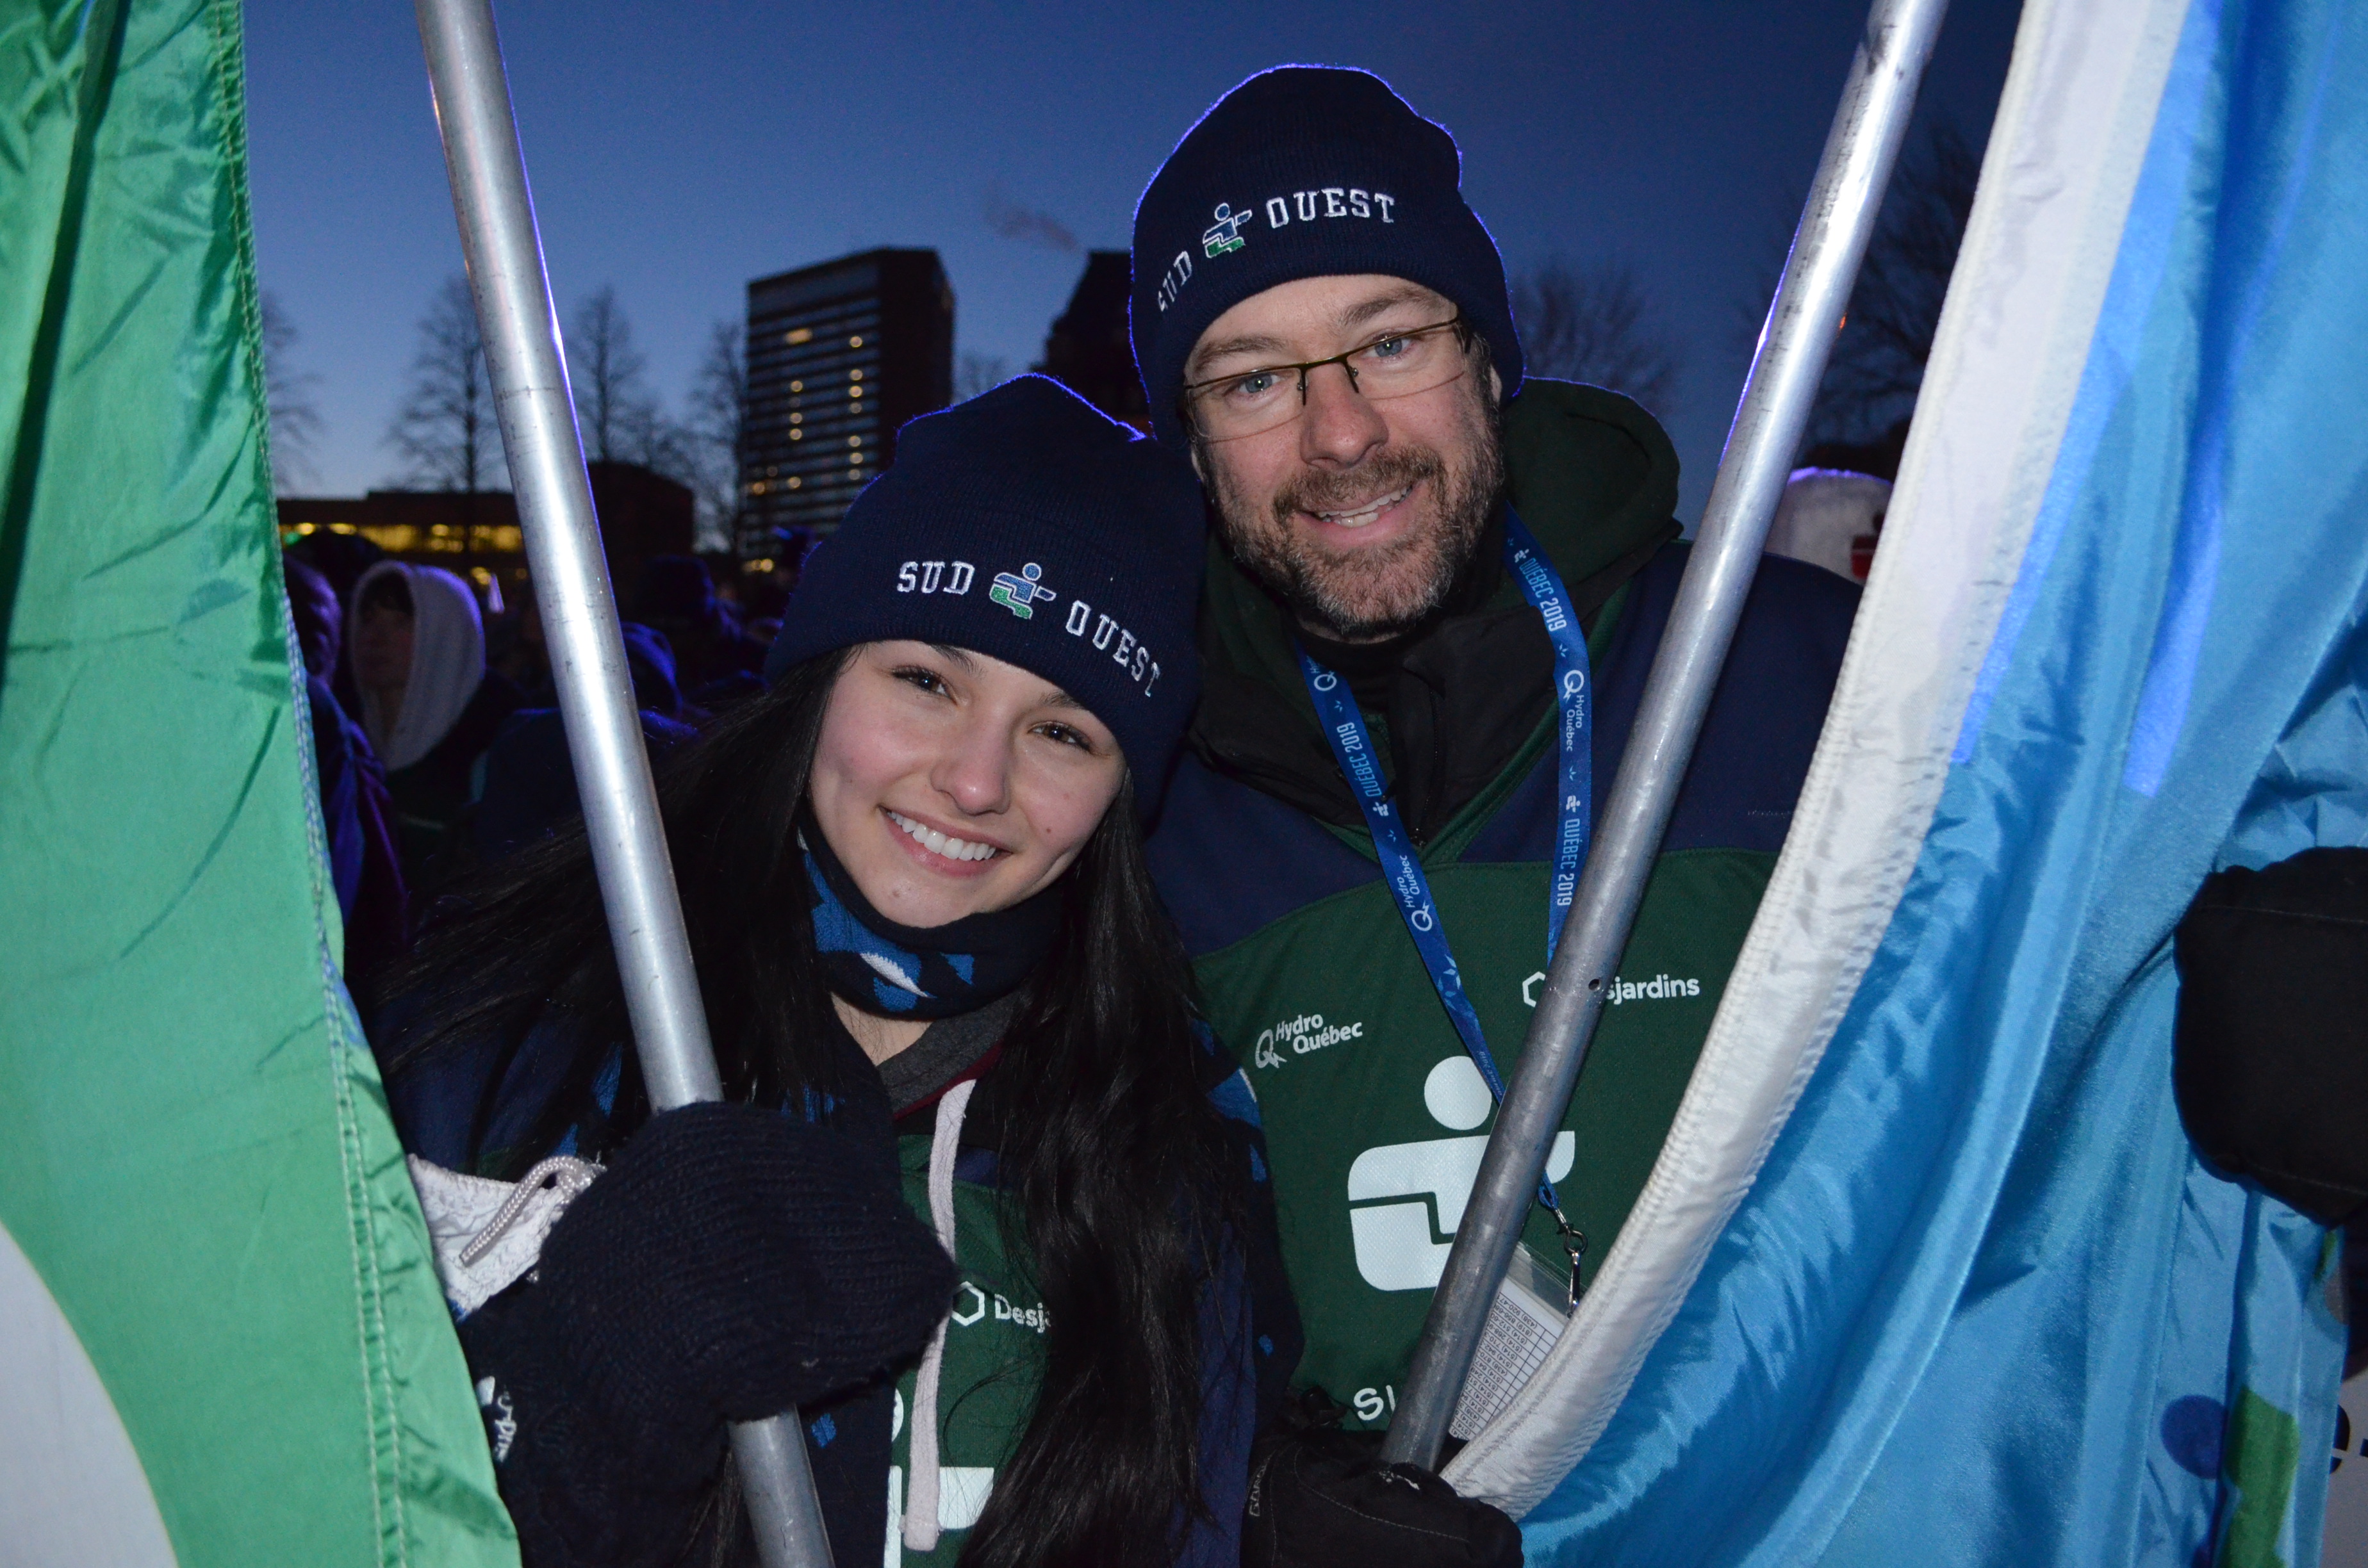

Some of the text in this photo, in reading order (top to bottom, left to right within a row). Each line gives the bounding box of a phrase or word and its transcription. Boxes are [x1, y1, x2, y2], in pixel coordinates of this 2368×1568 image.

[1266, 187, 1395, 229] OUEST
[1519, 557, 1567, 632] QUÉBEC 2019
[897, 560, 1161, 698] SUD OUEST
[1566, 709, 1575, 751] Québec
[1575, 694, 1584, 728] Hydro
[1336, 722, 1383, 797] QUÉBEC 2019
[1399, 854, 1420, 895] Québec
[1557, 818, 1583, 906] QUÉBEC 2019
[1397, 876, 1416, 908] Hydro
[1276, 1014, 1324, 1041] Hydro
[1292, 1022, 1363, 1054] Québec
